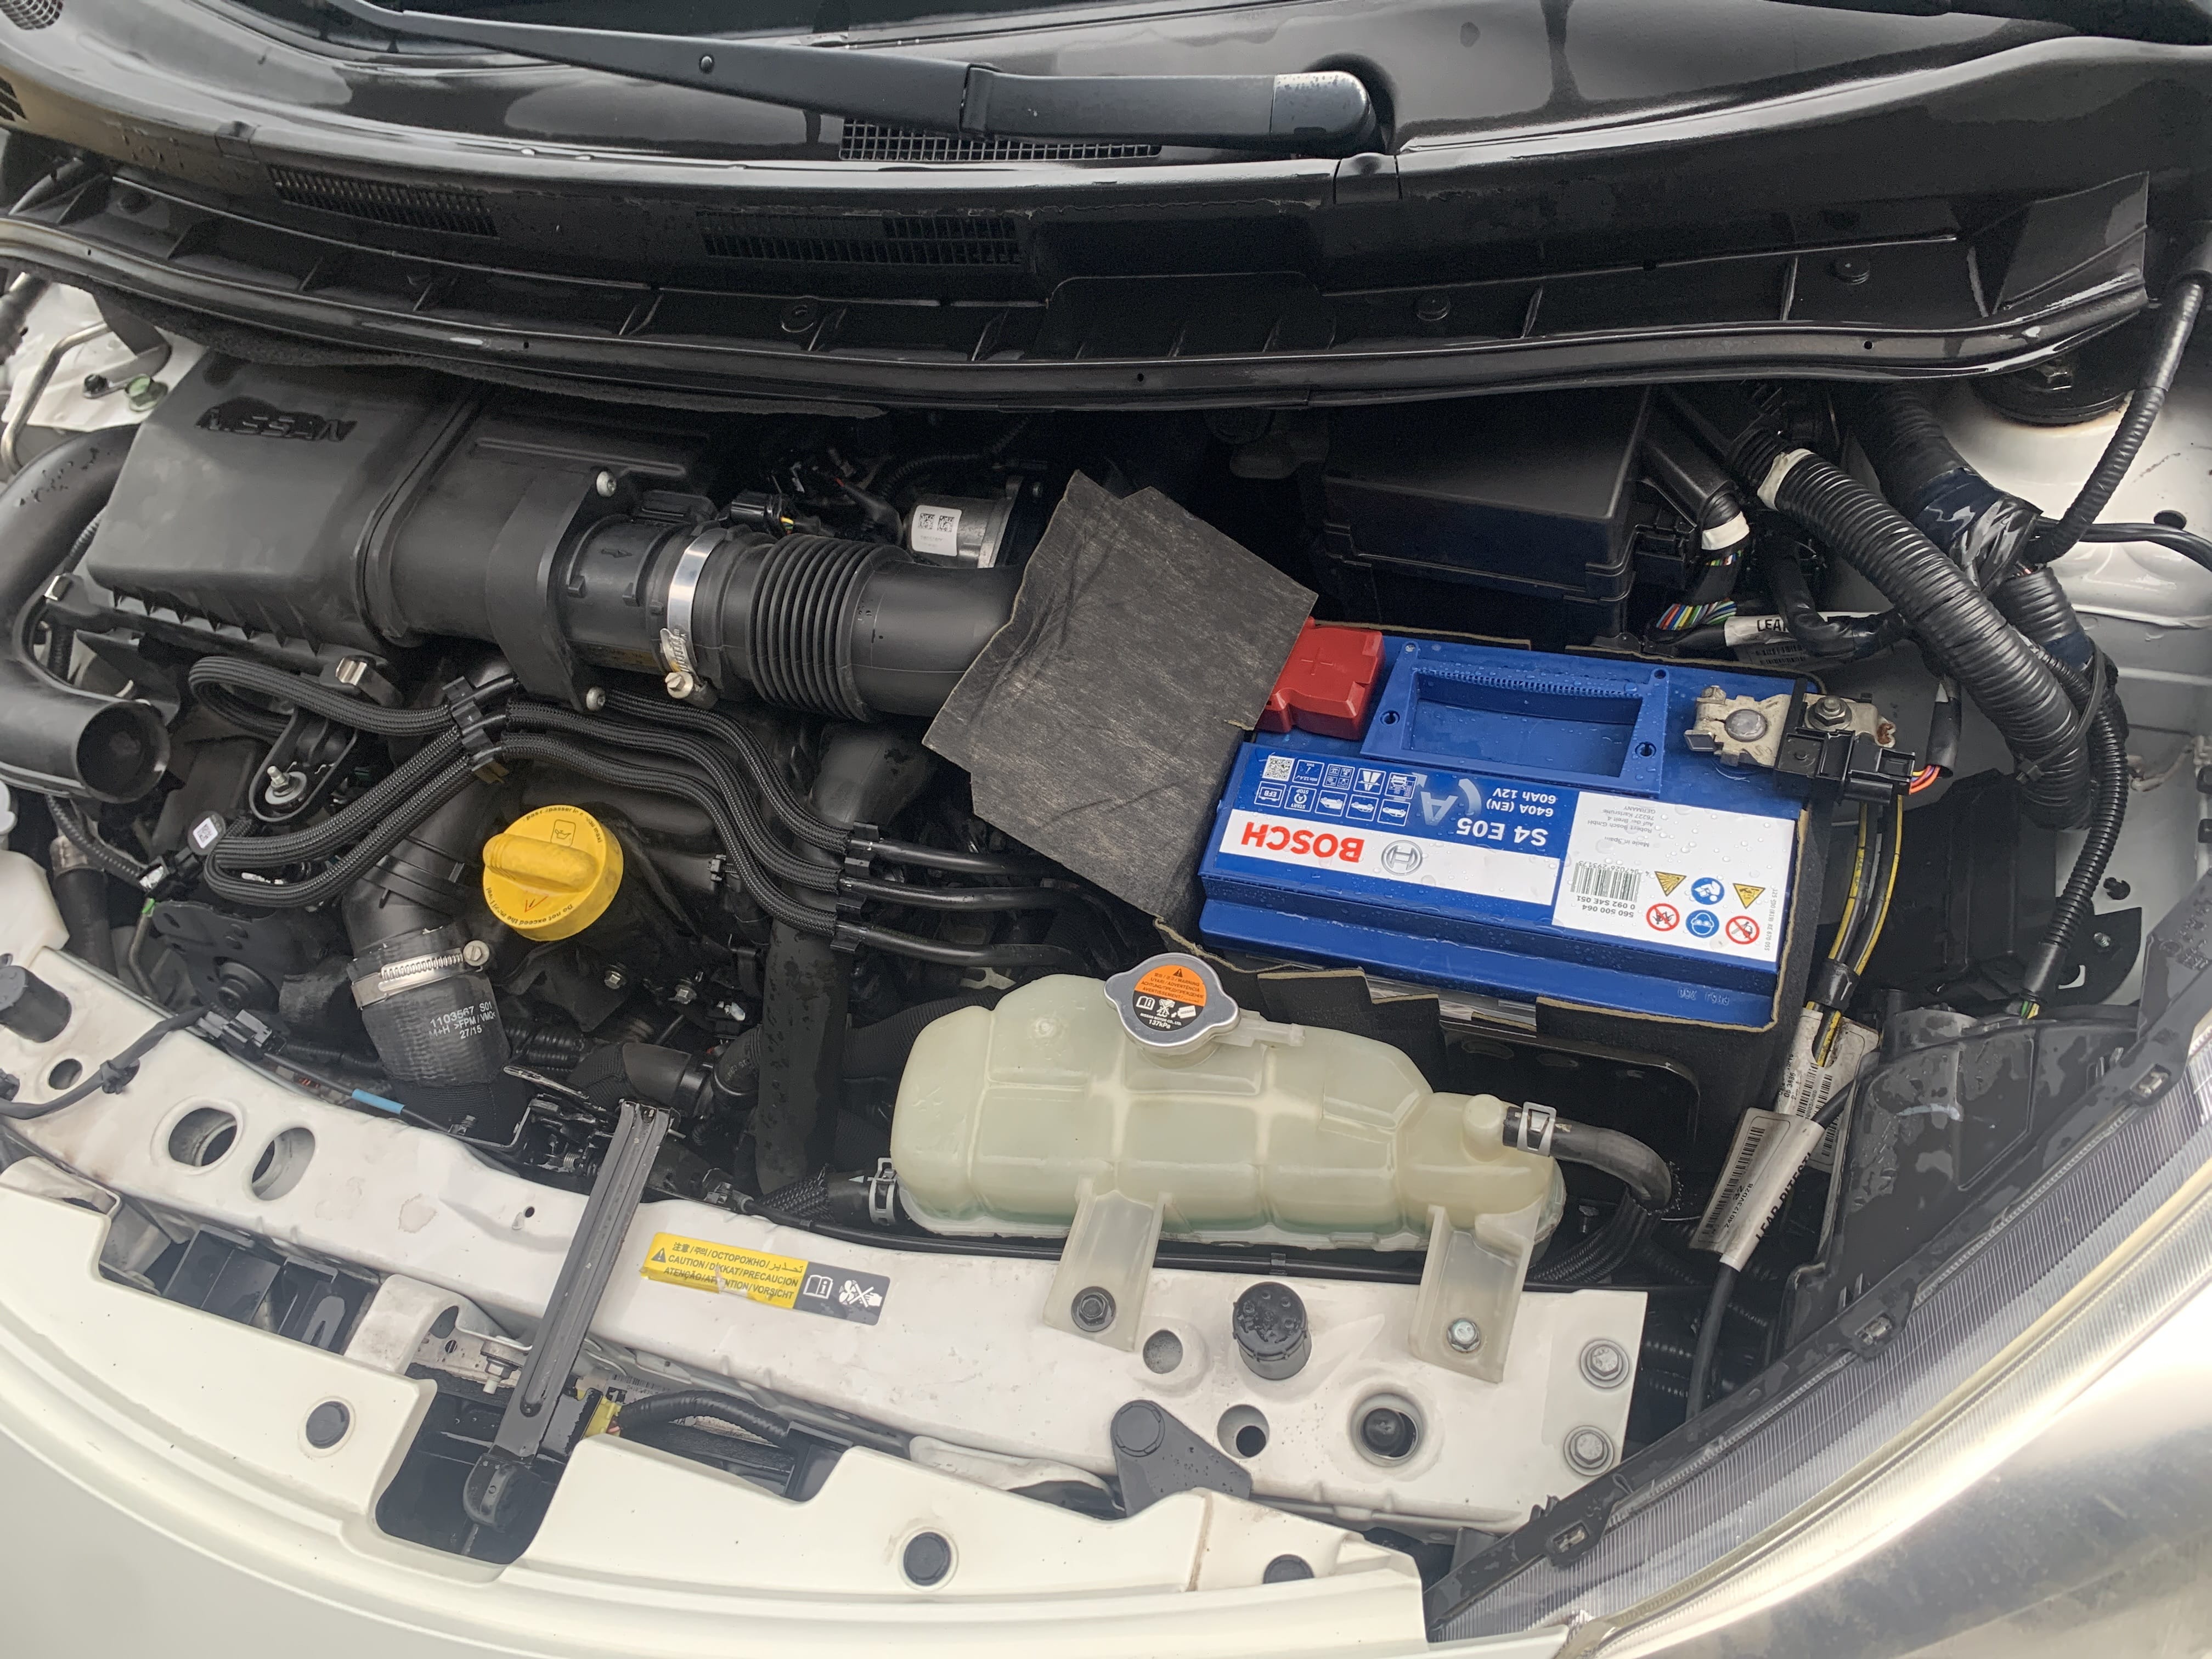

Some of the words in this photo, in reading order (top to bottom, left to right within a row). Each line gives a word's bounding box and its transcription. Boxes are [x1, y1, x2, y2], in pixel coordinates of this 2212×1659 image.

[1757, 619, 1786, 631] LEA
[1492, 788, 1519, 799] 12V
[1522, 792, 1556, 804] 60Ah
[1486, 798, 1515, 812] (EN)
[1623, 806, 1656, 814] GERMANY
[1519, 804, 1554, 817] 640A
[1603, 809, 1633, 817] Karlsruhe
[1634, 813, 1654, 821] 76227
[1456, 817, 1505, 841] E05
[1630, 825, 1652, 833] Robert
[1514, 826, 1549, 847] S4
[1241, 821, 1365, 863] BOSCH
[1577, 895, 1592, 904] 051
[1594, 898, 1610, 906] S4E
[563, 904, 574, 913] Do
[1582, 904, 1598, 912] 064
[1612, 901, 1628, 909] 092
[1600, 907, 1616, 915] 500
[1618, 910, 1634, 918] 560
[507, 915, 519, 925] the
[549, 912, 561, 921] not
[1178, 978, 1200, 986] WARNING
[430, 1006, 475, 1028] 1103567
[479, 1001, 492, 1012] S01
[1148, 1019, 1171, 1029] 137kPa
[428, 1024, 450, 1037] M+H
[460, 1025, 482, 1040] 27/15
[1733, 1185, 1746, 1200] 32
